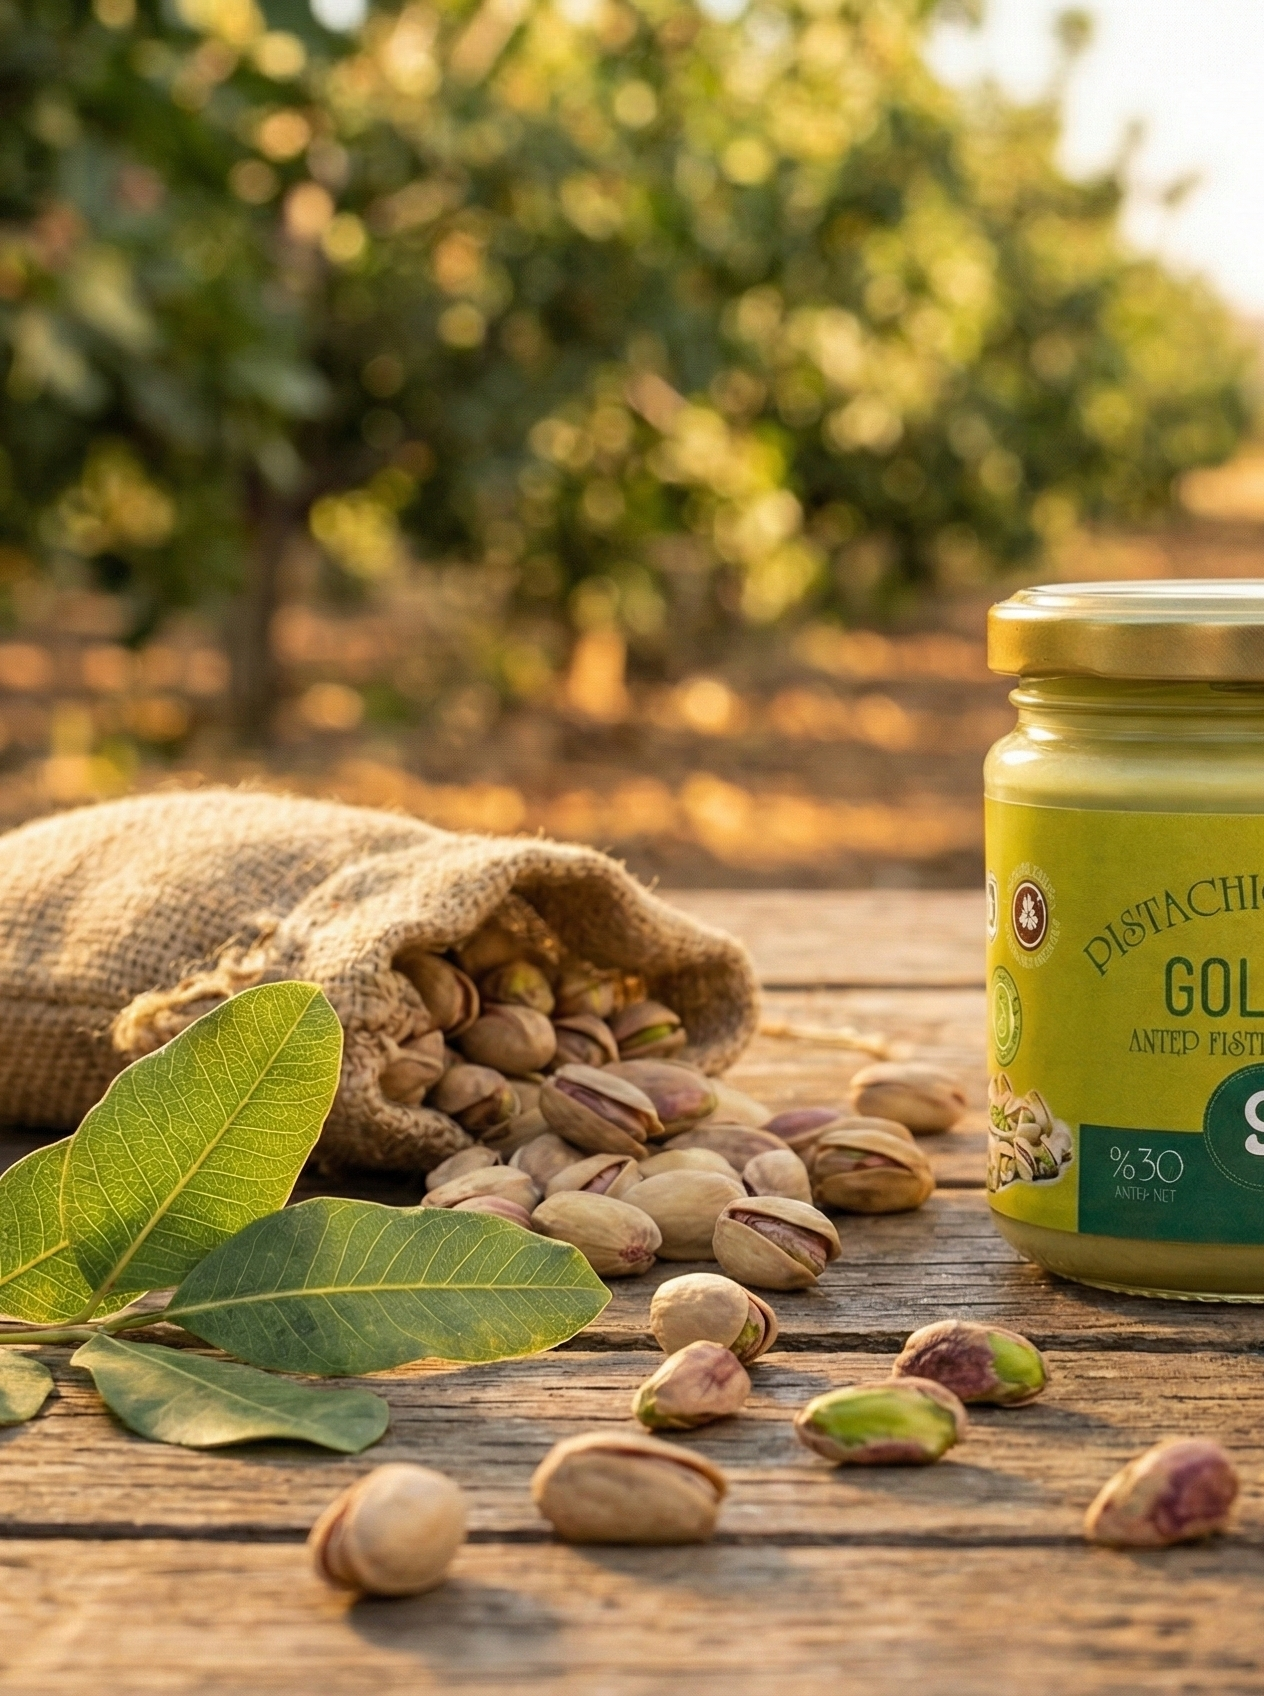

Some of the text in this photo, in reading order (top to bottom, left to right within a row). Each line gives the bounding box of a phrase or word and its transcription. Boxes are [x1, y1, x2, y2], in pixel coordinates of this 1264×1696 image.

[1129, 1028, 1200, 1056] ANTEP
[1110, 1146, 1184, 1183] %30
[1153, 1188, 1177, 1203] NET
